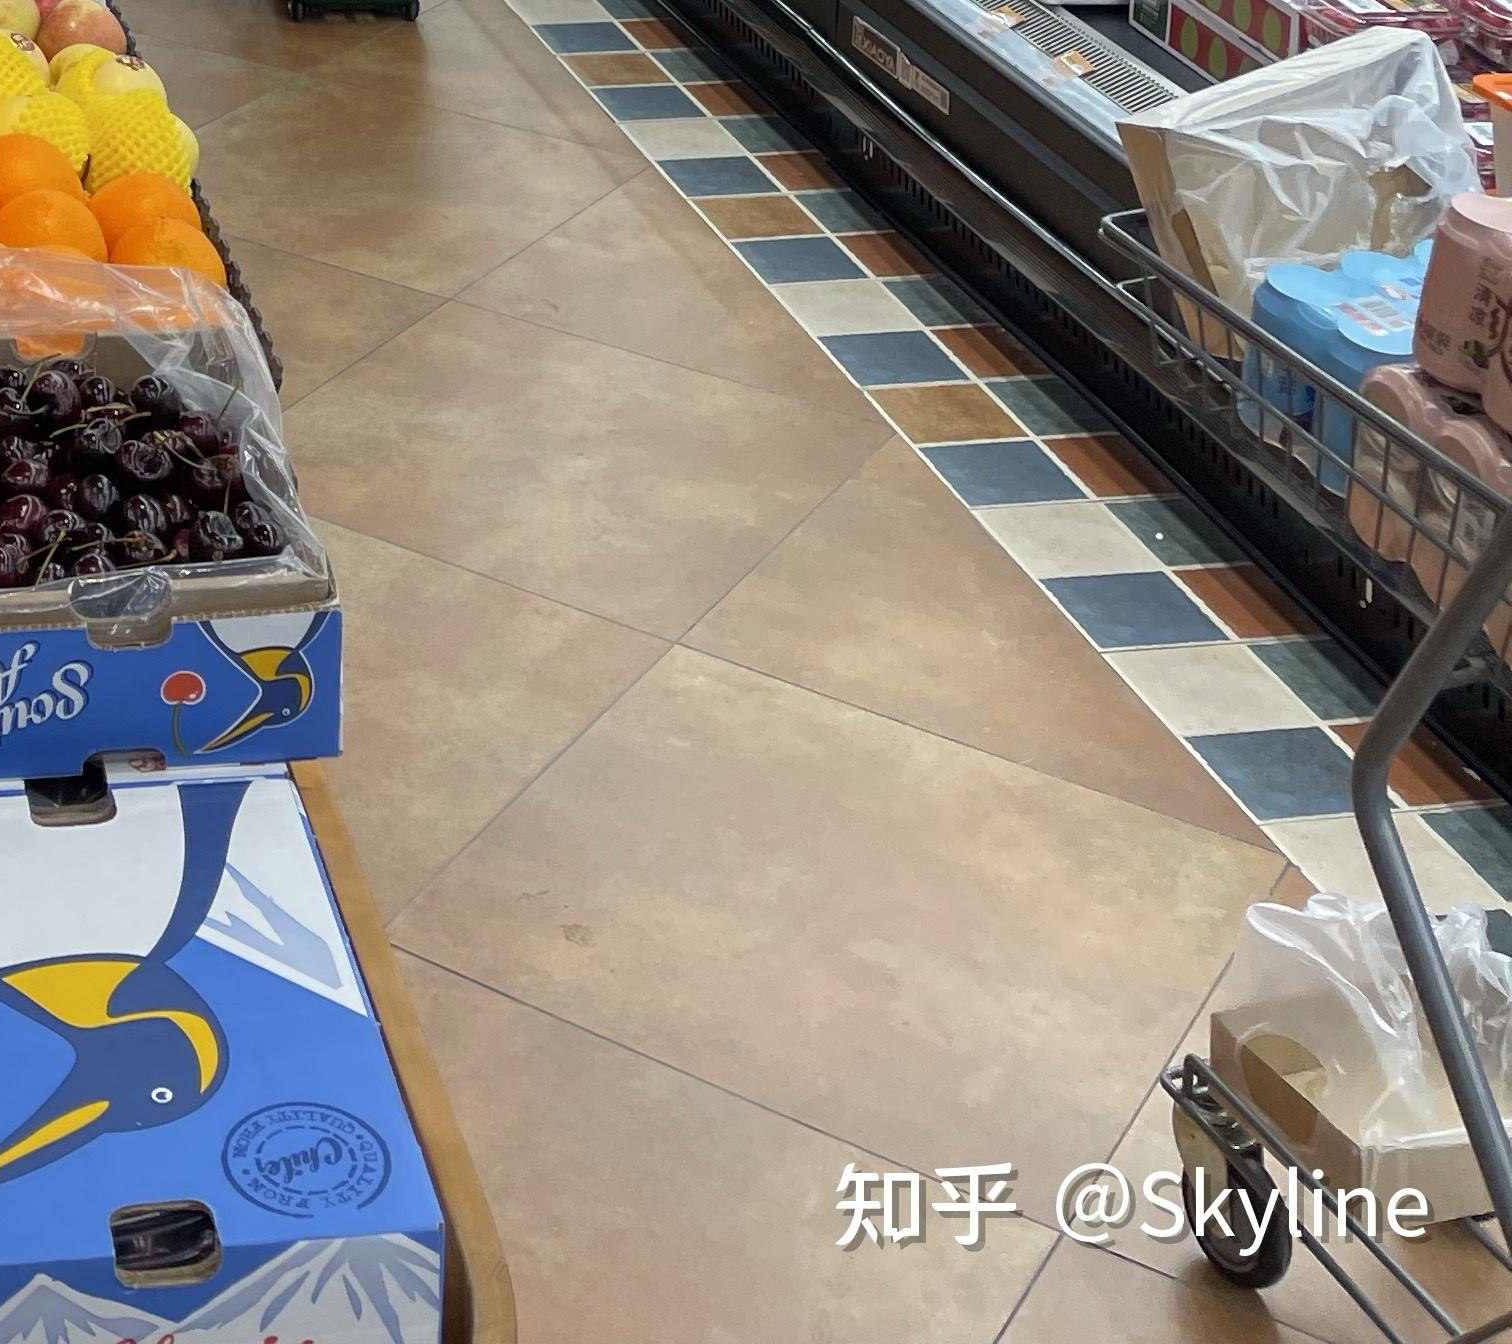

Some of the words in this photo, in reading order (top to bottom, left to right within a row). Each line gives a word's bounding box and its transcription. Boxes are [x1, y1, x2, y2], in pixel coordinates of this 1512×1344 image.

[267, 1110, 356, 1135] QUALITY
[255, 1135, 343, 1185] Chile
[320, 1139, 379, 1209] QUALITY
